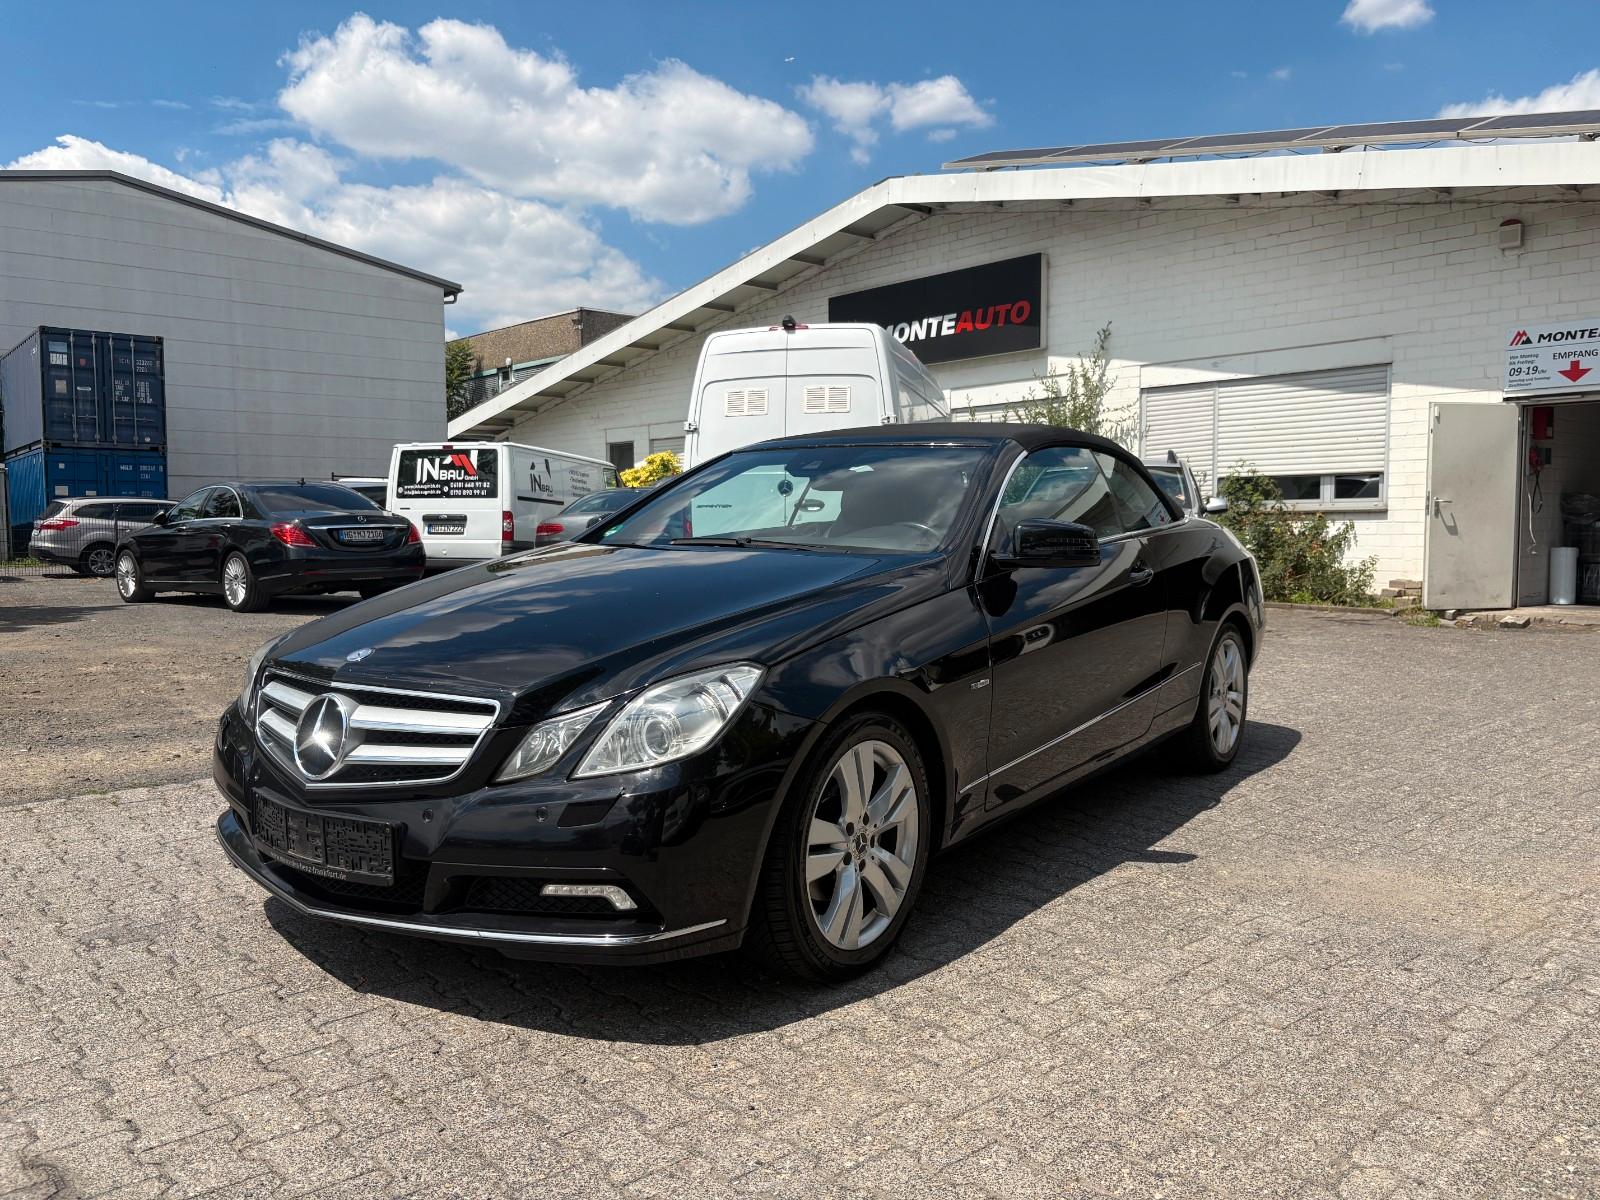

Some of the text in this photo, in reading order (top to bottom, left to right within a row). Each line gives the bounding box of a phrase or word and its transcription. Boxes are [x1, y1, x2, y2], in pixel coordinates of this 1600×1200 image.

[1537, 327, 1600, 344] MONTE
[1552, 348, 1599, 361] EMPFANG
[1508, 366, 1539, 377] 09-19
